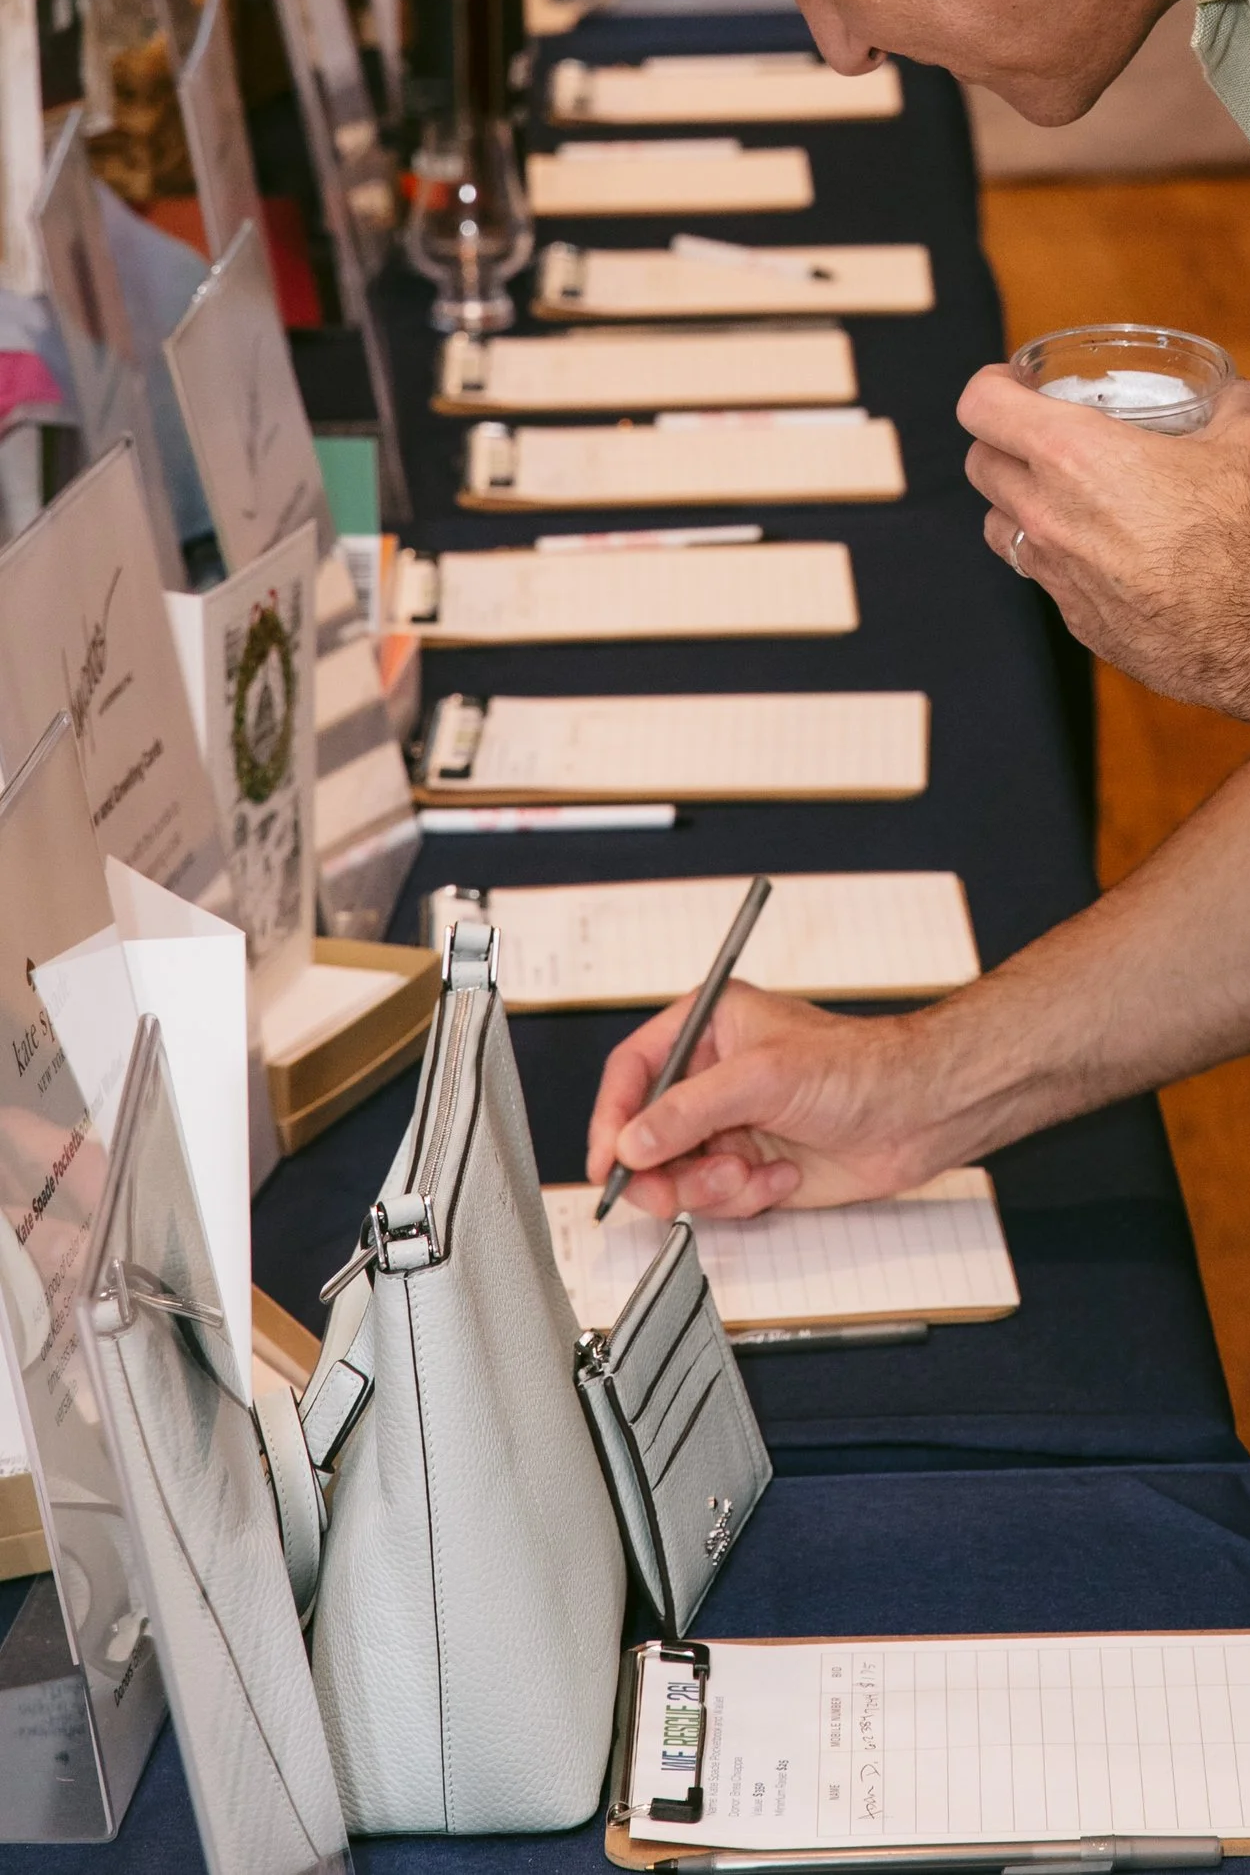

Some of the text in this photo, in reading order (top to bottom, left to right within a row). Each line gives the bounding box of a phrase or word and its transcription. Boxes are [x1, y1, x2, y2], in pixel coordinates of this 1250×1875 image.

[12, 1024, 40, 1078] kate
[36, 1065, 52, 1098] NEW
[15, 1212, 34, 1248] Kate
[32, 1175, 56, 1221] Spade
[52, 1107, 93, 1185] Pocketbook
[831, 1666, 842, 1678] BID
[663, 1704, 701, 1747] RESCUE
[830, 1696, 842, 1748] MOBILE NUMBER
[661, 1750, 697, 1772] WE
[709, 1761, 721, 1782] Spade
[776, 1759, 789, 1772] $25
[829, 1784, 841, 1801] NAME
